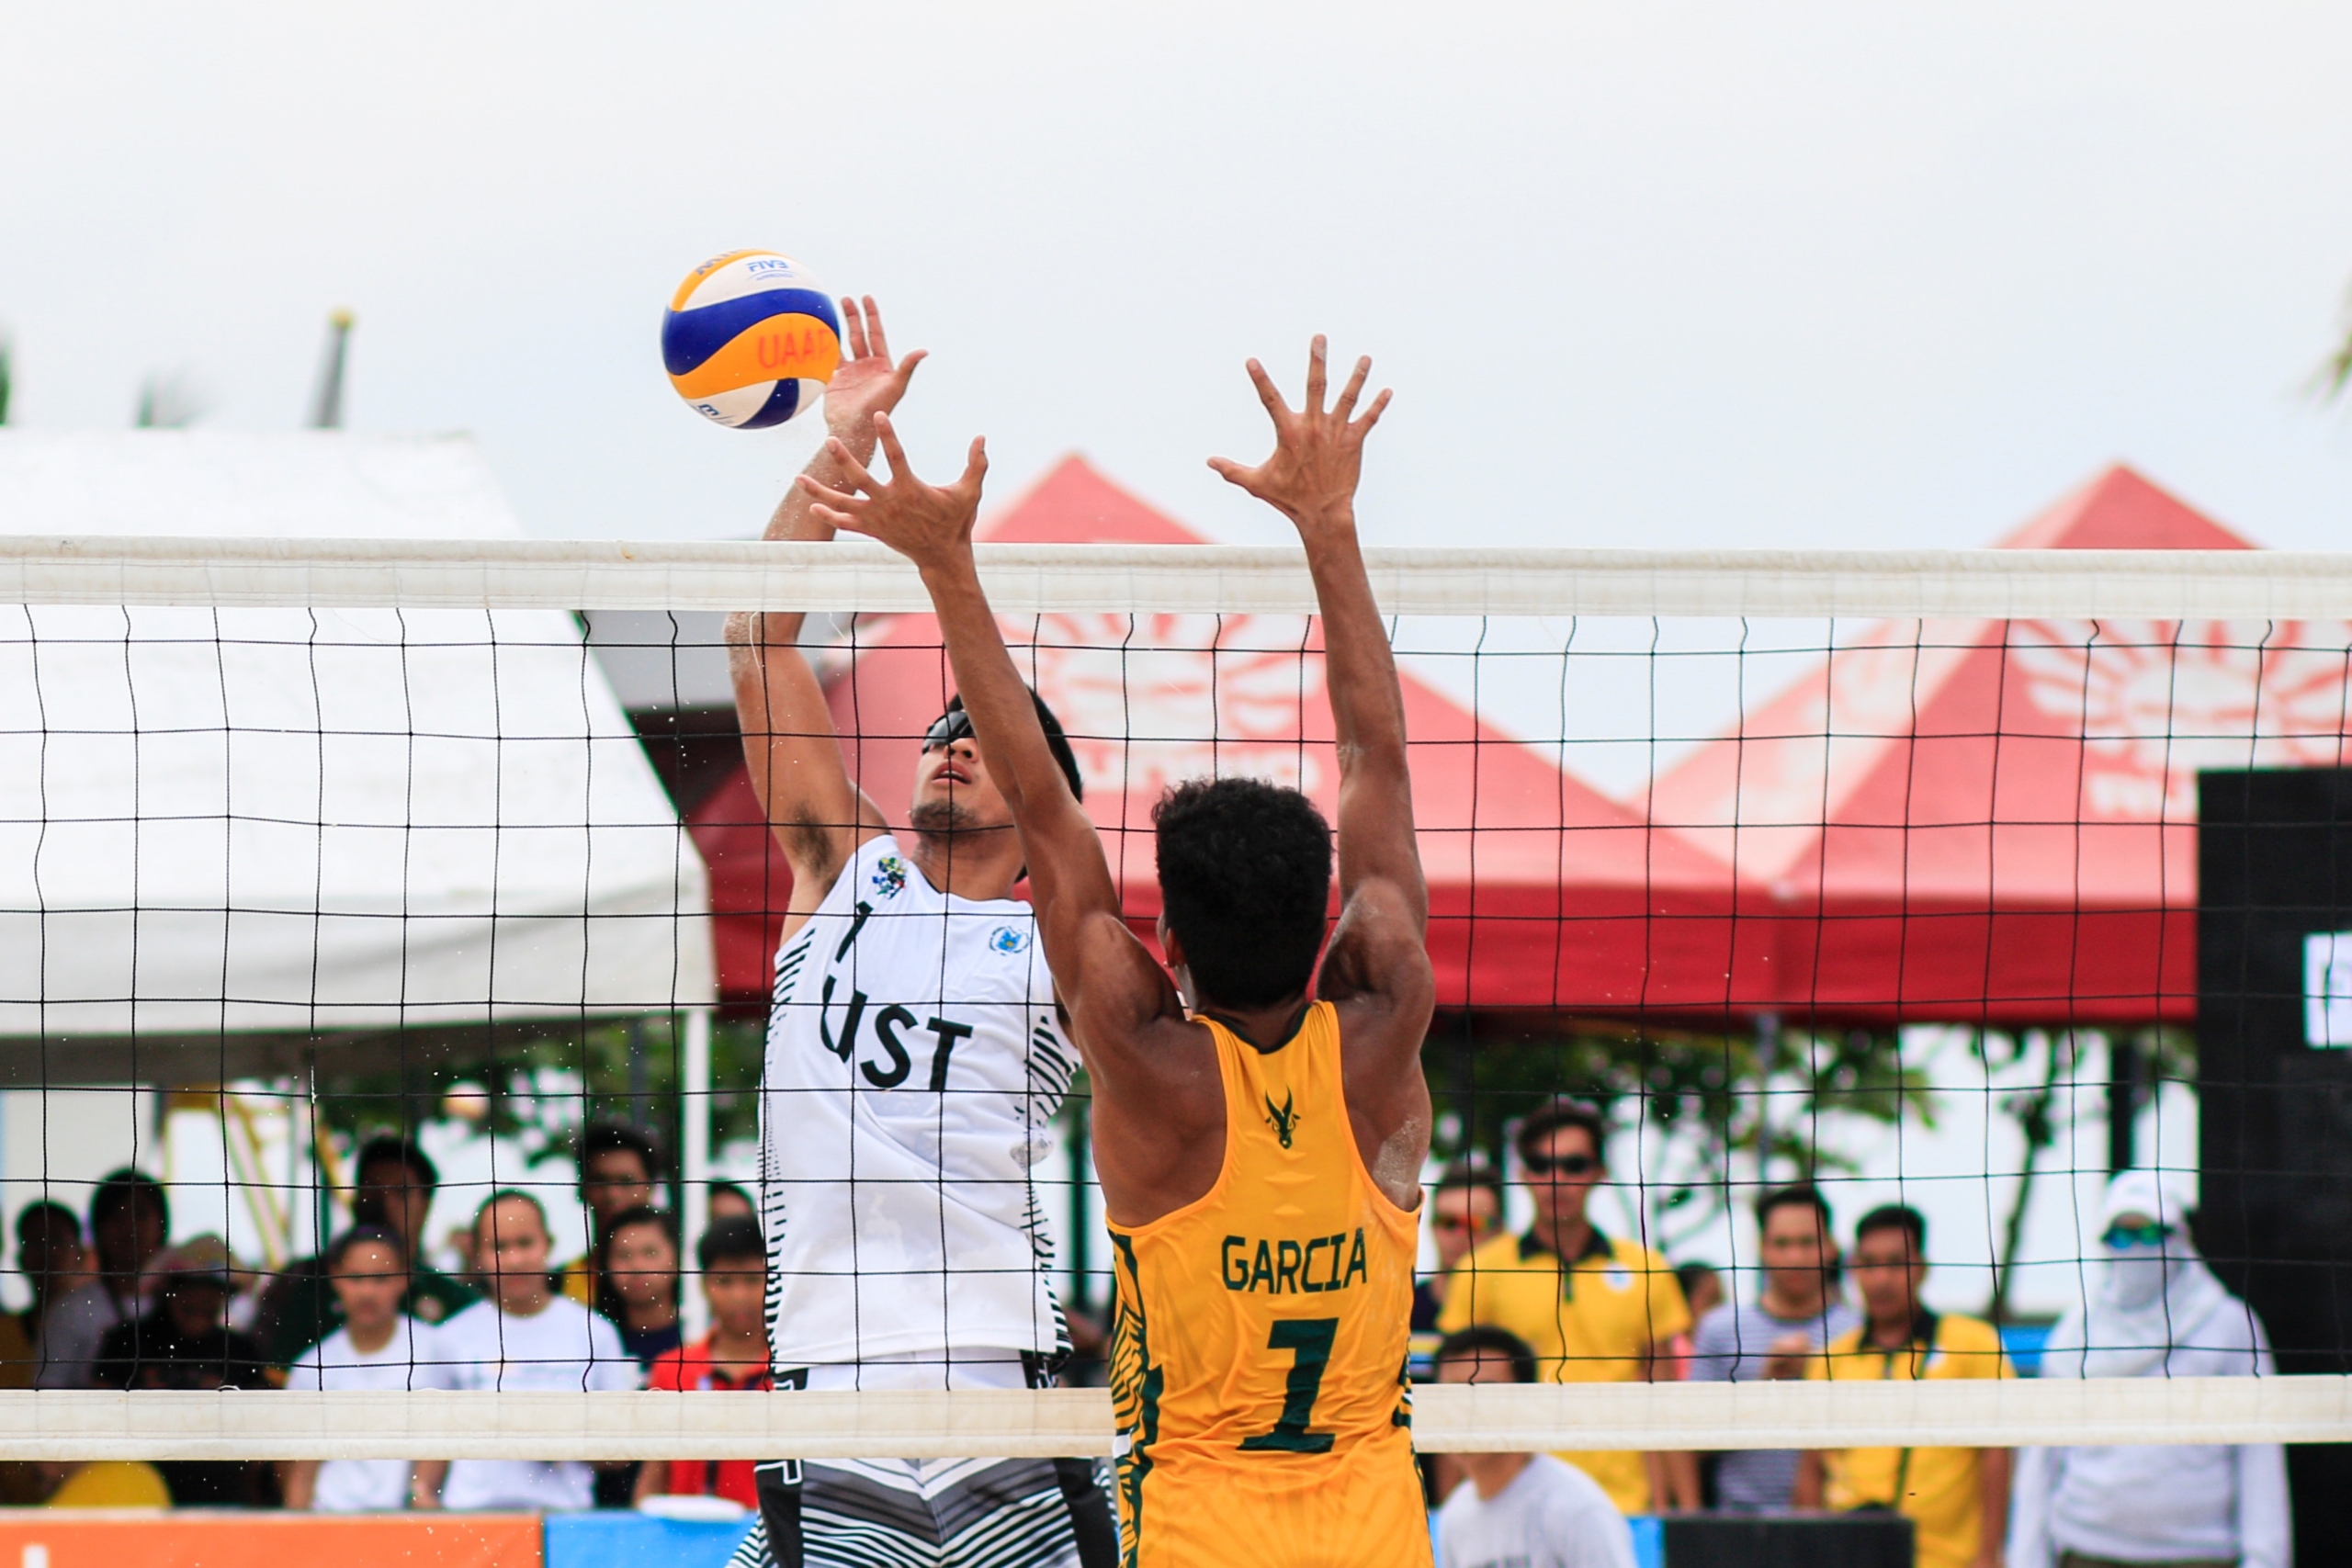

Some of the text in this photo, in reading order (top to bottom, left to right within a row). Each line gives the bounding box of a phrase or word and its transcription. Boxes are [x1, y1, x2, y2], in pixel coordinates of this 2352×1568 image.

[757, 328, 832, 369] UAAP
[820, 974, 974, 1093] UST
[1221, 1226, 1368, 1294] GARCIA
[1236, 1316, 1340, 1453] 1
